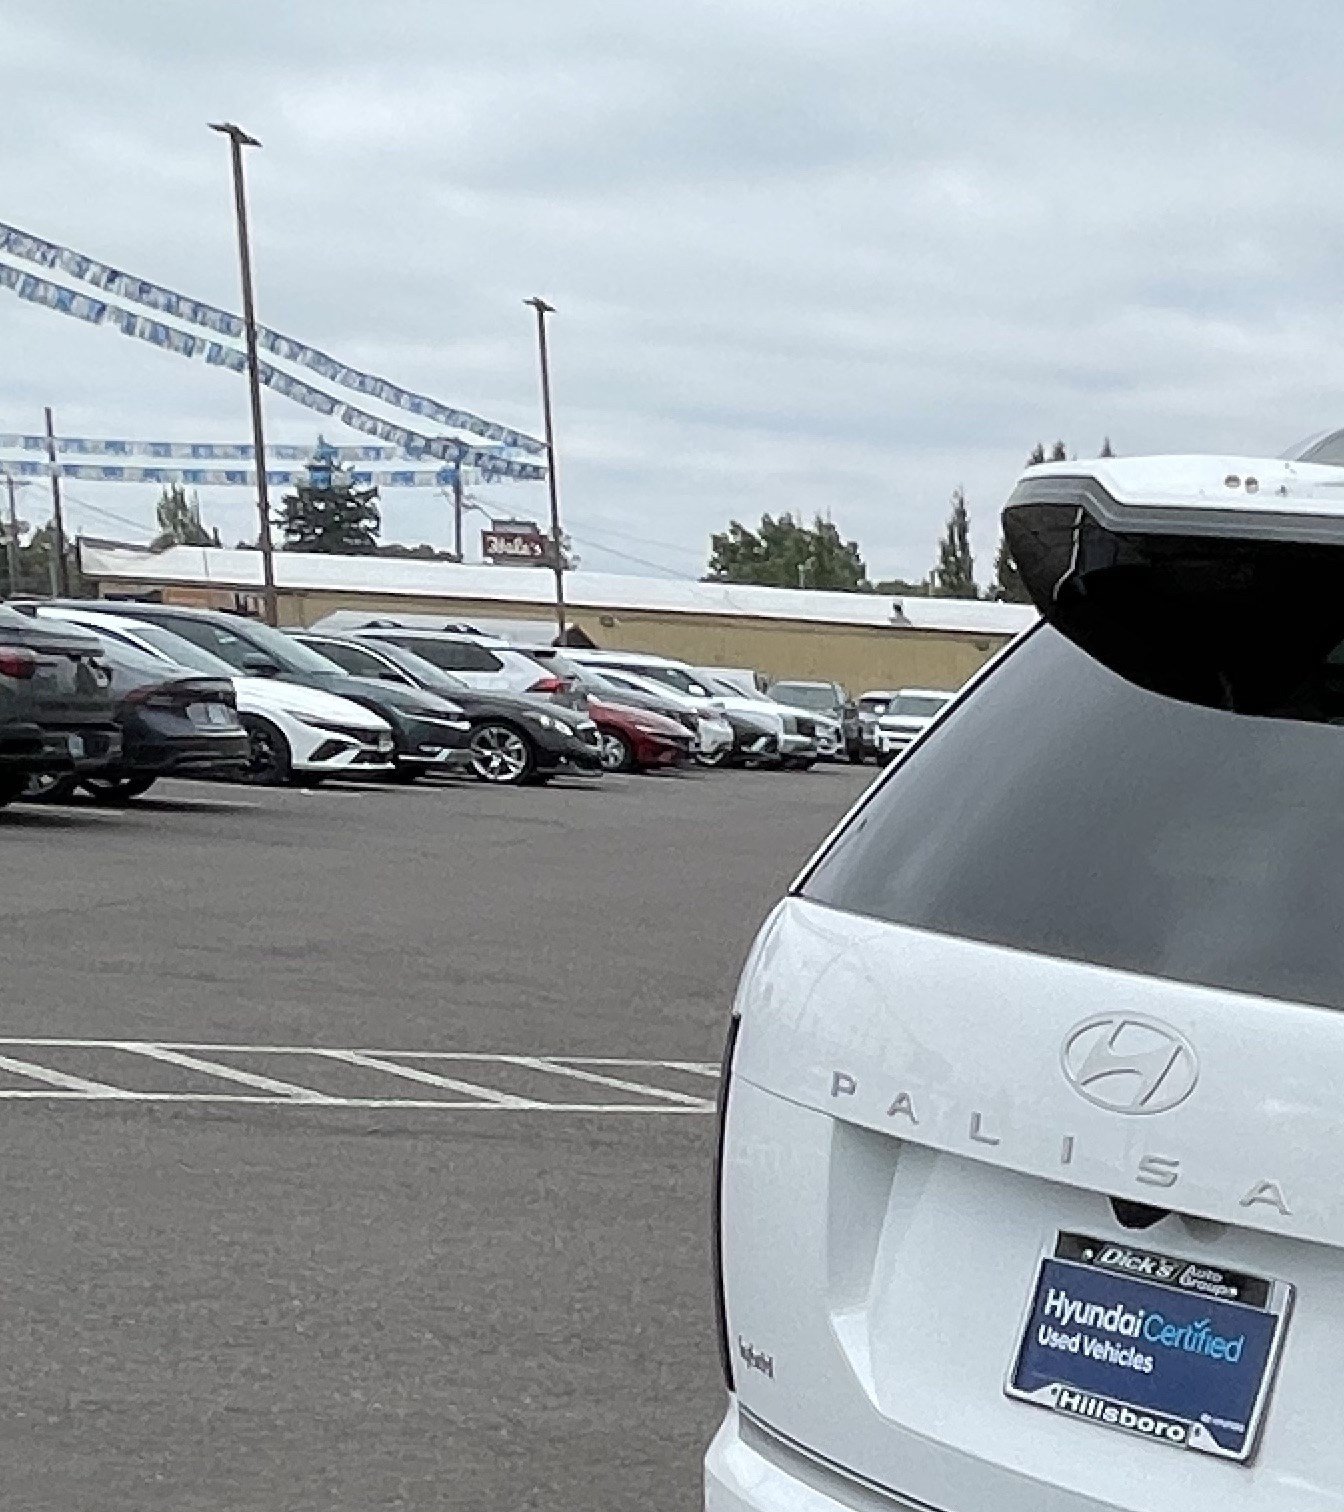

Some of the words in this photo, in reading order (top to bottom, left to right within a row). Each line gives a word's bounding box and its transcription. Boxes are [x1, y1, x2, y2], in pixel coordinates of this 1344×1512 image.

[1100, 1249, 1174, 1278] Dick's
[1038, 1324, 1082, 1354] Used
[1083, 1334, 1155, 1374] Vehicles
[1059, 1390, 1186, 1442] Hillsboro
